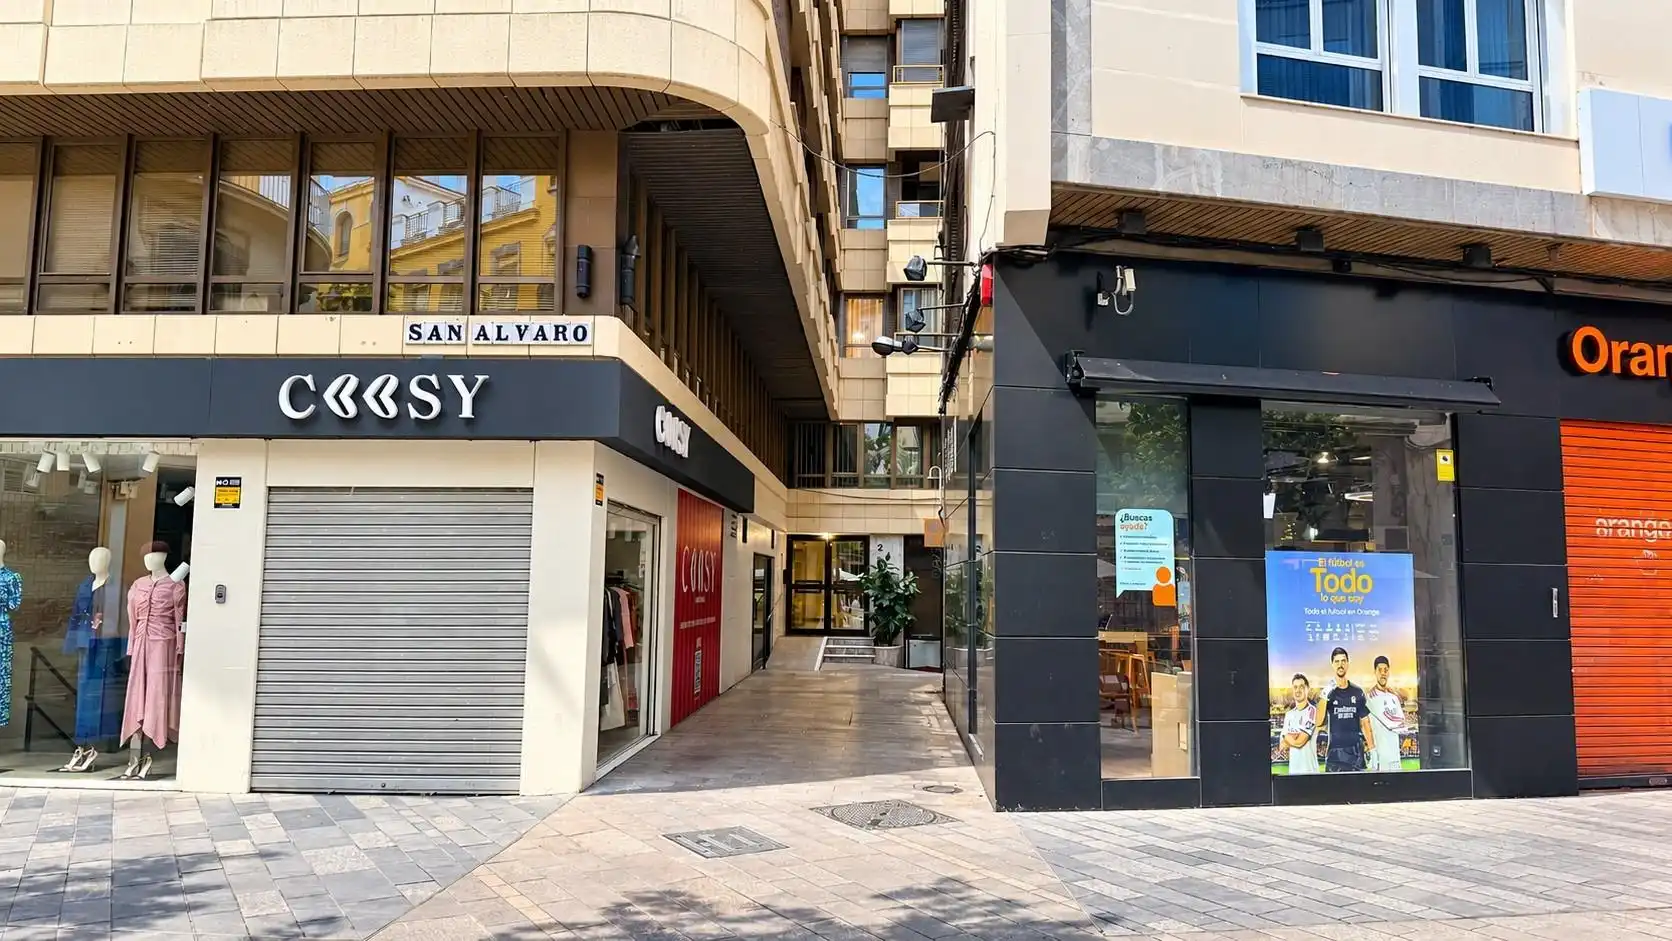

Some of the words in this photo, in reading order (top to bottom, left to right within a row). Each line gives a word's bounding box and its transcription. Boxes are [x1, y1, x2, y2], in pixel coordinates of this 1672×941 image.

[408, 324, 462, 341] SAN
[474, 324, 588, 342] ALVARO
[877, 543, 884, 552] 2
[1310, 567, 1373, 594] Todo
[1320, 592, 1329, 602] lo
